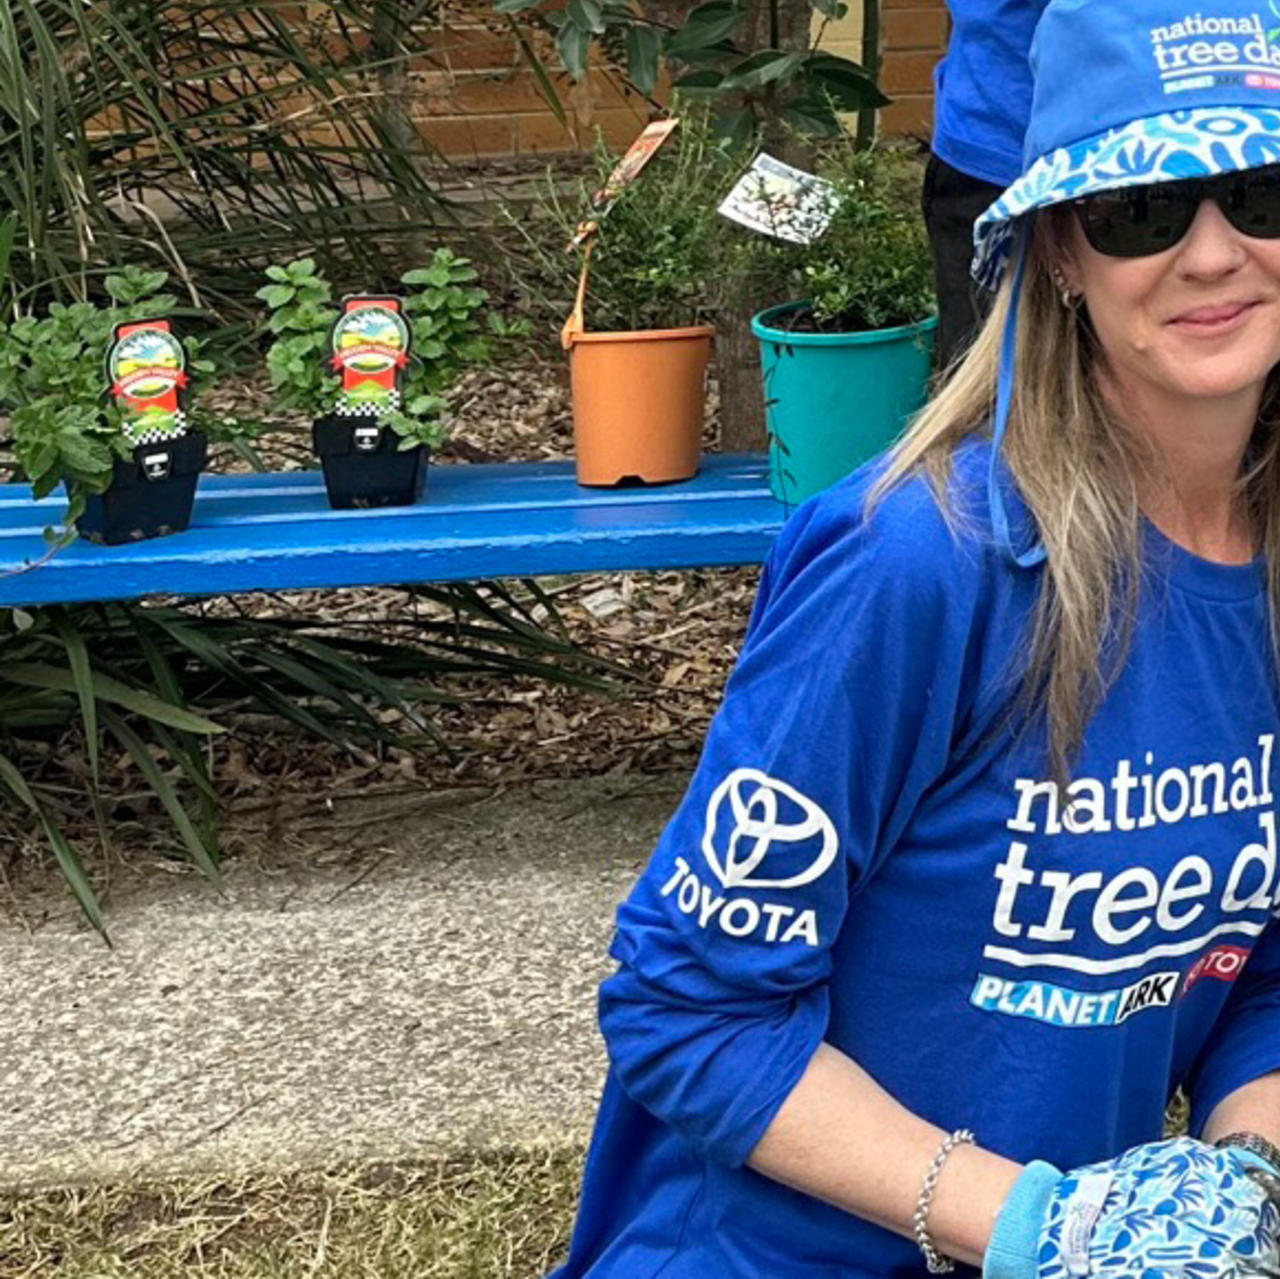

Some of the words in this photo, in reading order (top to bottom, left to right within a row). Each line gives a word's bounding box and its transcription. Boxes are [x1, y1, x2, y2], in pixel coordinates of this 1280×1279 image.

[1151, 12, 1264, 44] national
[1153, 41, 1240, 71] tree
[1006, 733, 1275, 835] national
[660, 857, 819, 946] TOYOTA
[992, 841, 1212, 947] tree
[976, 978, 1116, 1025] PLANET
[1118, 975, 1175, 1020] ARK
